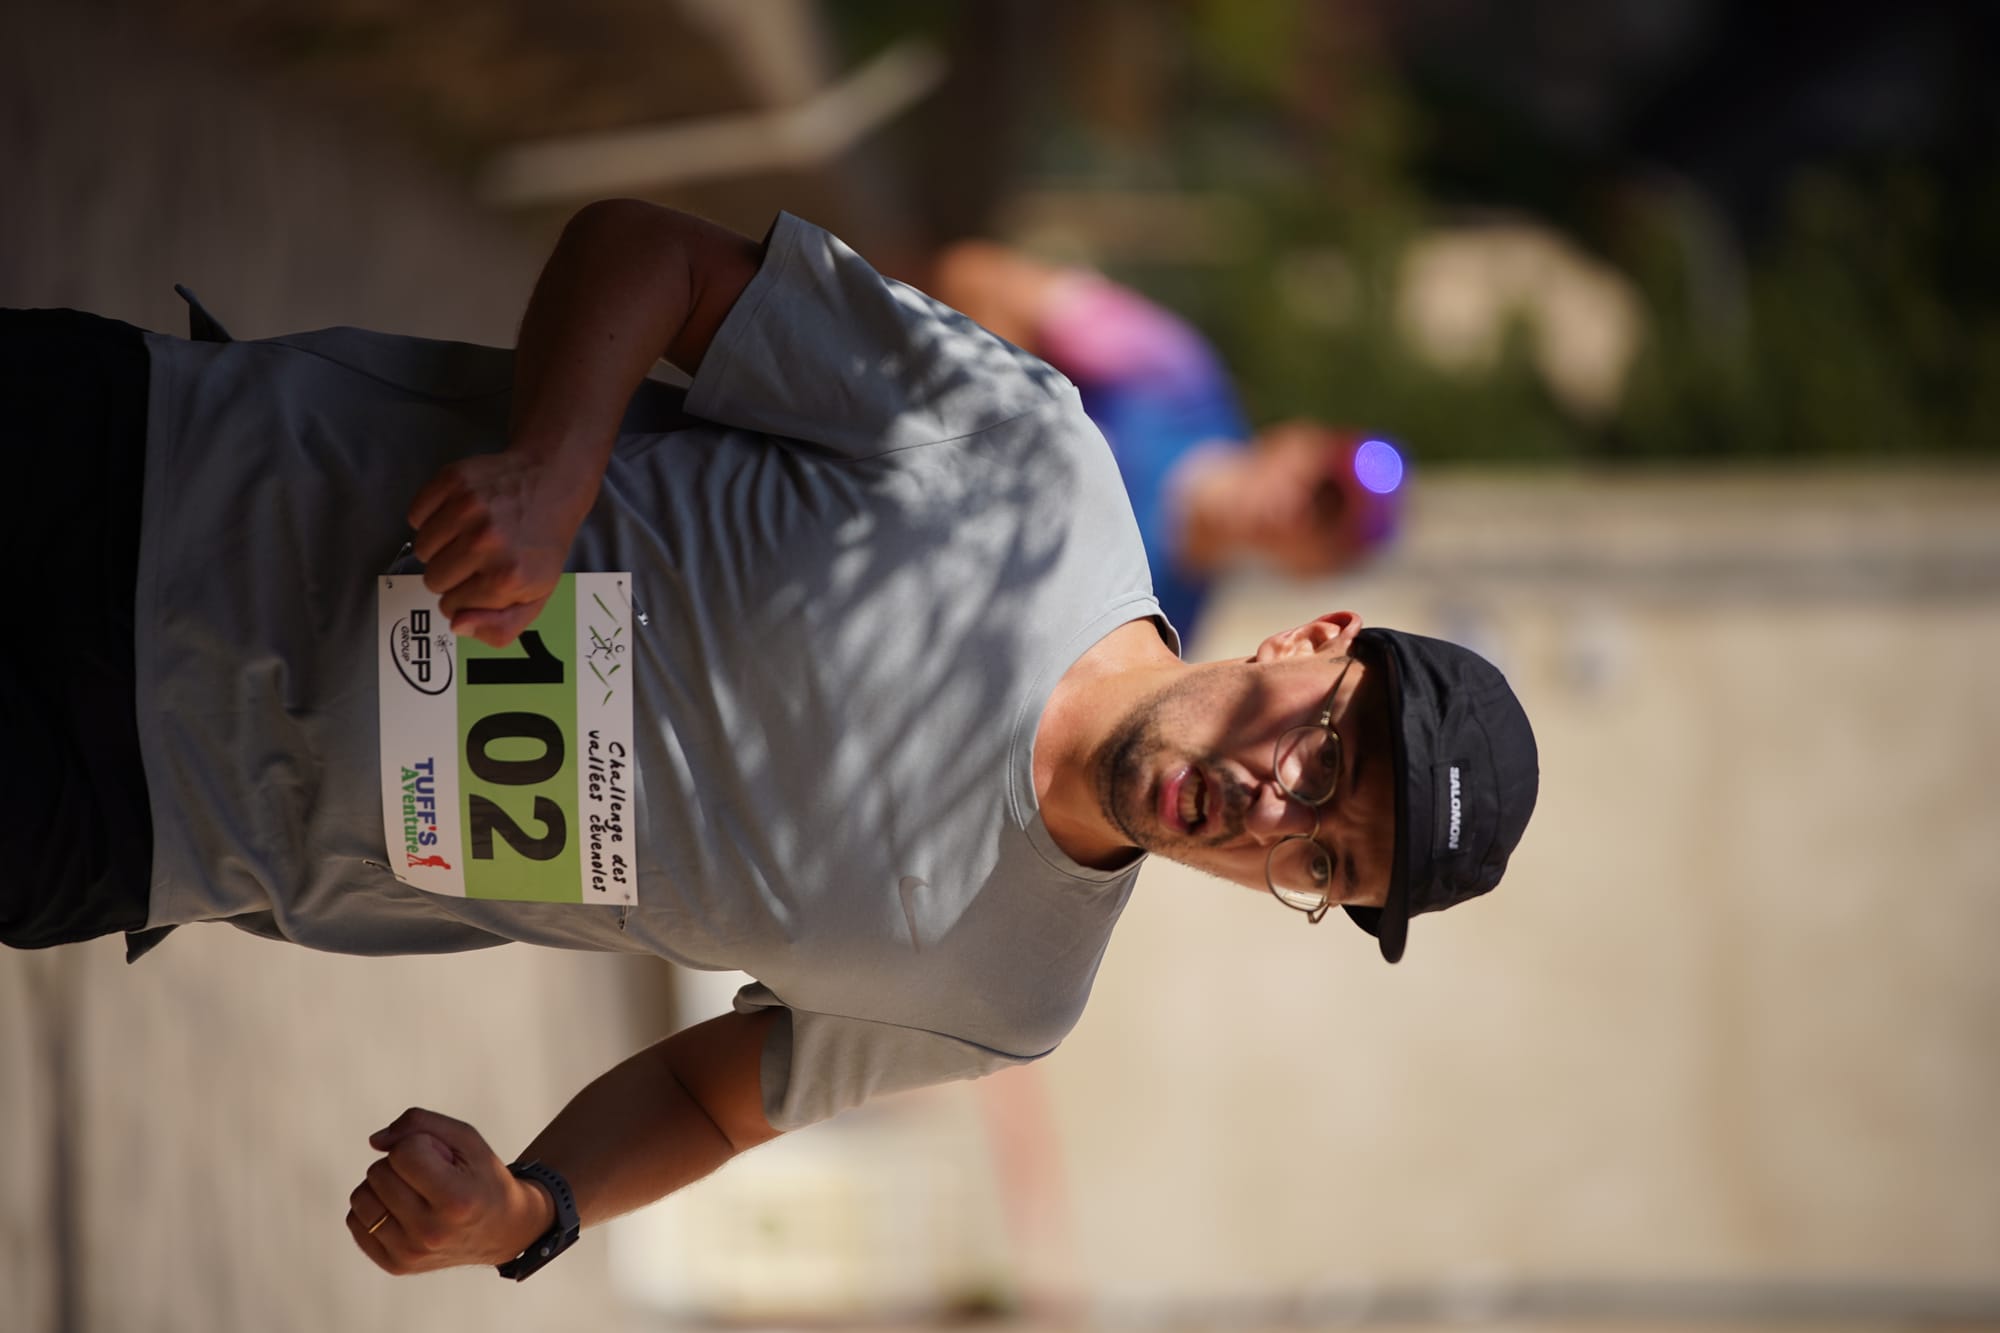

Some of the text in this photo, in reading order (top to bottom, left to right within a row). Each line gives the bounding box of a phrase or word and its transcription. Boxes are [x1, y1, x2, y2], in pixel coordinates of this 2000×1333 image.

[401, 625, 410, 662] GROUP
[410, 609, 431, 682] BFP
[466, 630, 567, 861] 102
[400, 766, 420, 854] Aventure
[415, 757, 438, 846] TUFF'S
[588, 730, 608, 893] vallées cévenoles
[604, 741, 628, 884] Challenge des
[1448, 766, 1462, 849] SALOMON
